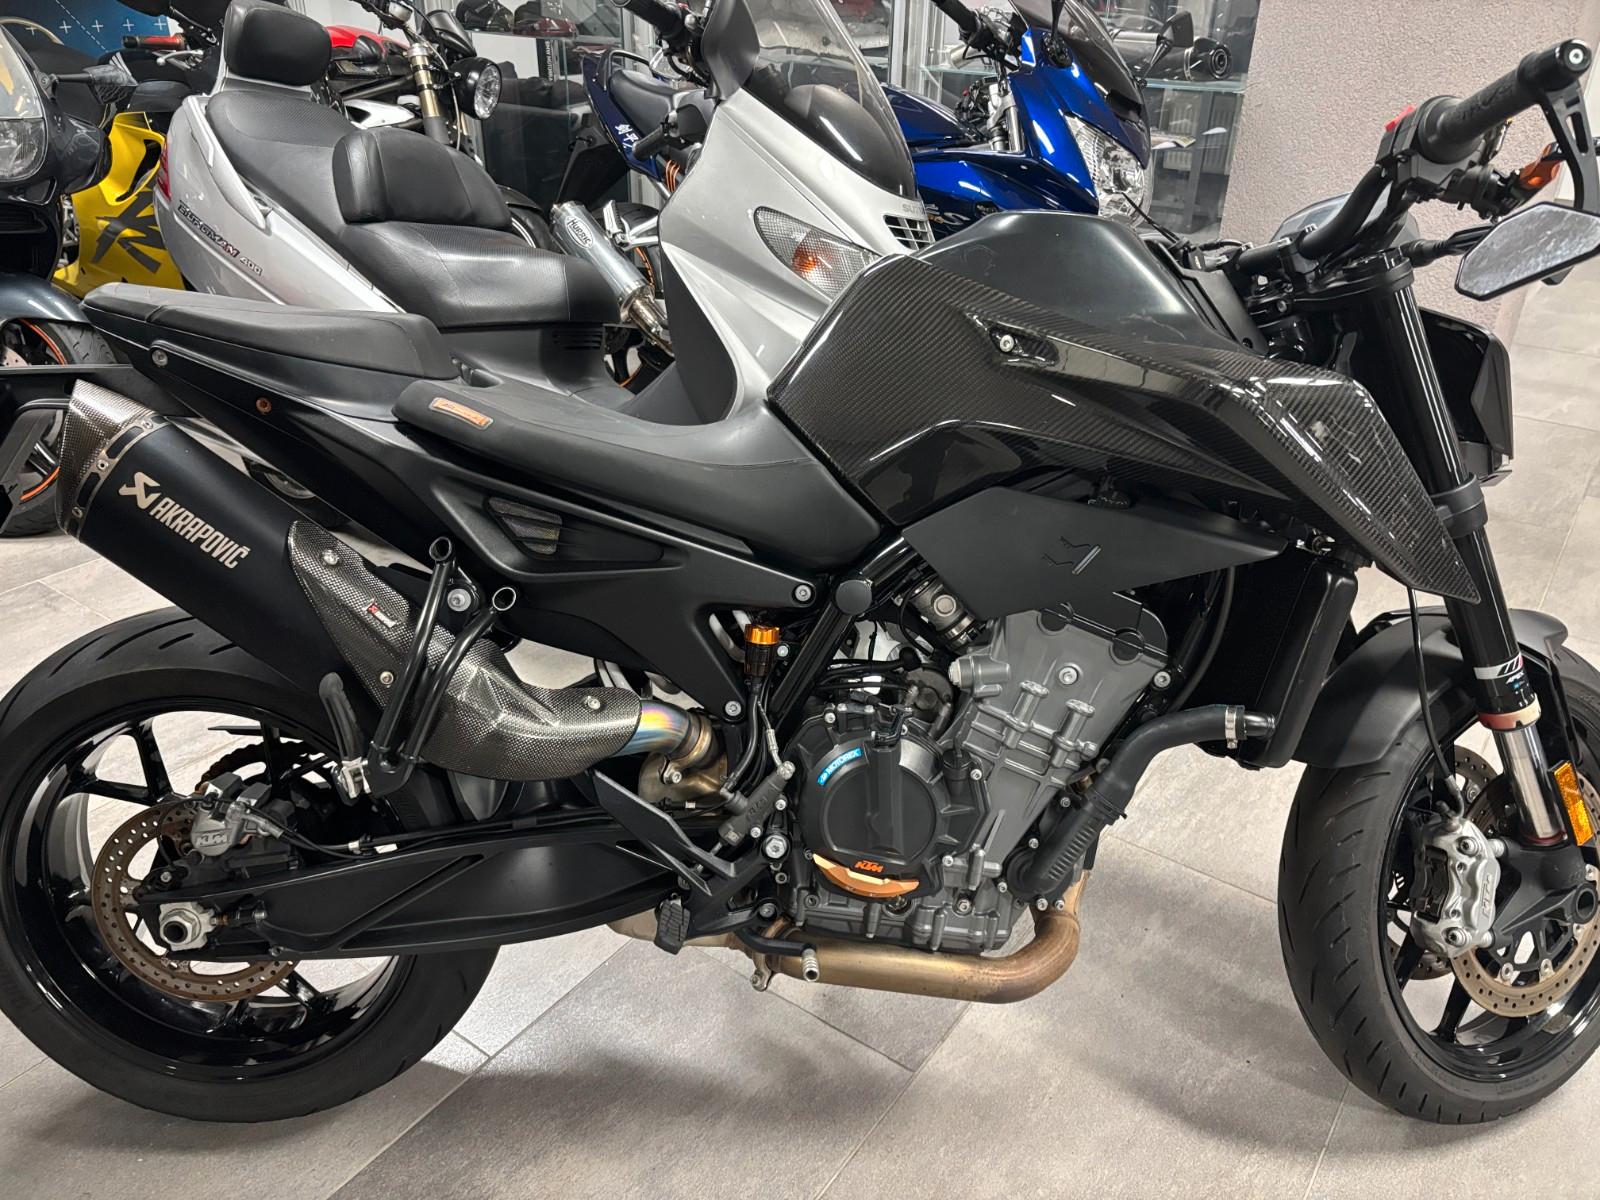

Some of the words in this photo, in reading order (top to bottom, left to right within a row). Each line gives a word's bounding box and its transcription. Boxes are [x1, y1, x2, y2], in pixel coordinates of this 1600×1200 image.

[178, 202, 240, 257] BURGMAN
[240, 257, 263, 276] 400
[826, 748, 860, 775] MOTOREX
[195, 831, 230, 848] KTM
[854, 860, 884, 873] KTM
